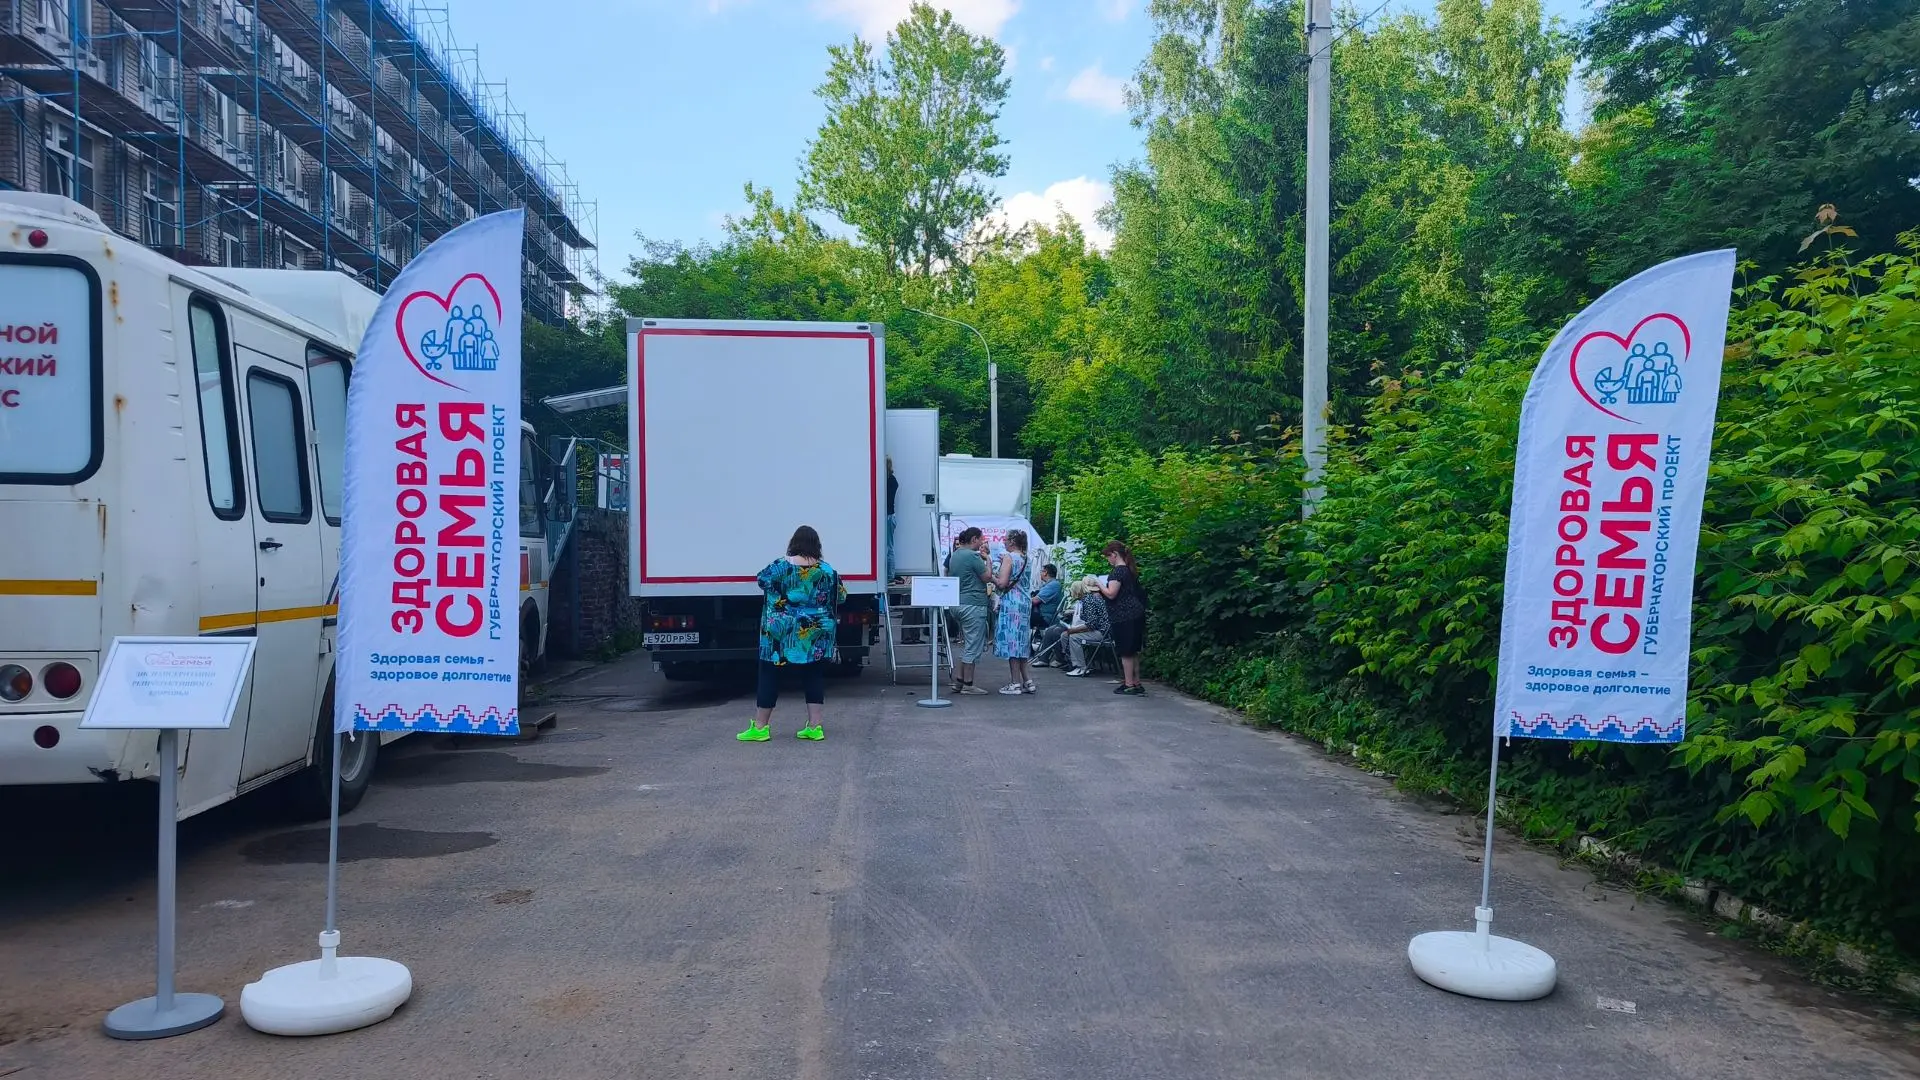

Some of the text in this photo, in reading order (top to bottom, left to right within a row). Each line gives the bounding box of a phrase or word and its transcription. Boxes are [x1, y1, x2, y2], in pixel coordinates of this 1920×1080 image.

[391, 403, 431, 634] ЗДОРОВАЯ
[435, 402, 486, 638] СЕМЬЯ
[489, 404, 506, 640] ГУБЕРНАТОРСКИЙ ПРОЕКТ
[1549, 435, 1596, 649] ЗДОРОВАЯ
[1590, 433, 1659, 655] СЕМЬЯ
[1643, 434, 1681, 655] ГУБЕРНАТОРСКИЙ ПРОЕКТ
[370, 653, 440, 666] Здоровая
[444, 655, 484, 665] семья
[370, 670, 512, 683] здоровое долголетие
[1525, 681, 1671, 695] здоровое долголетие
[1527, 665, 1592, 678] Здоровая
[1596, 669, 1636, 679] семья
